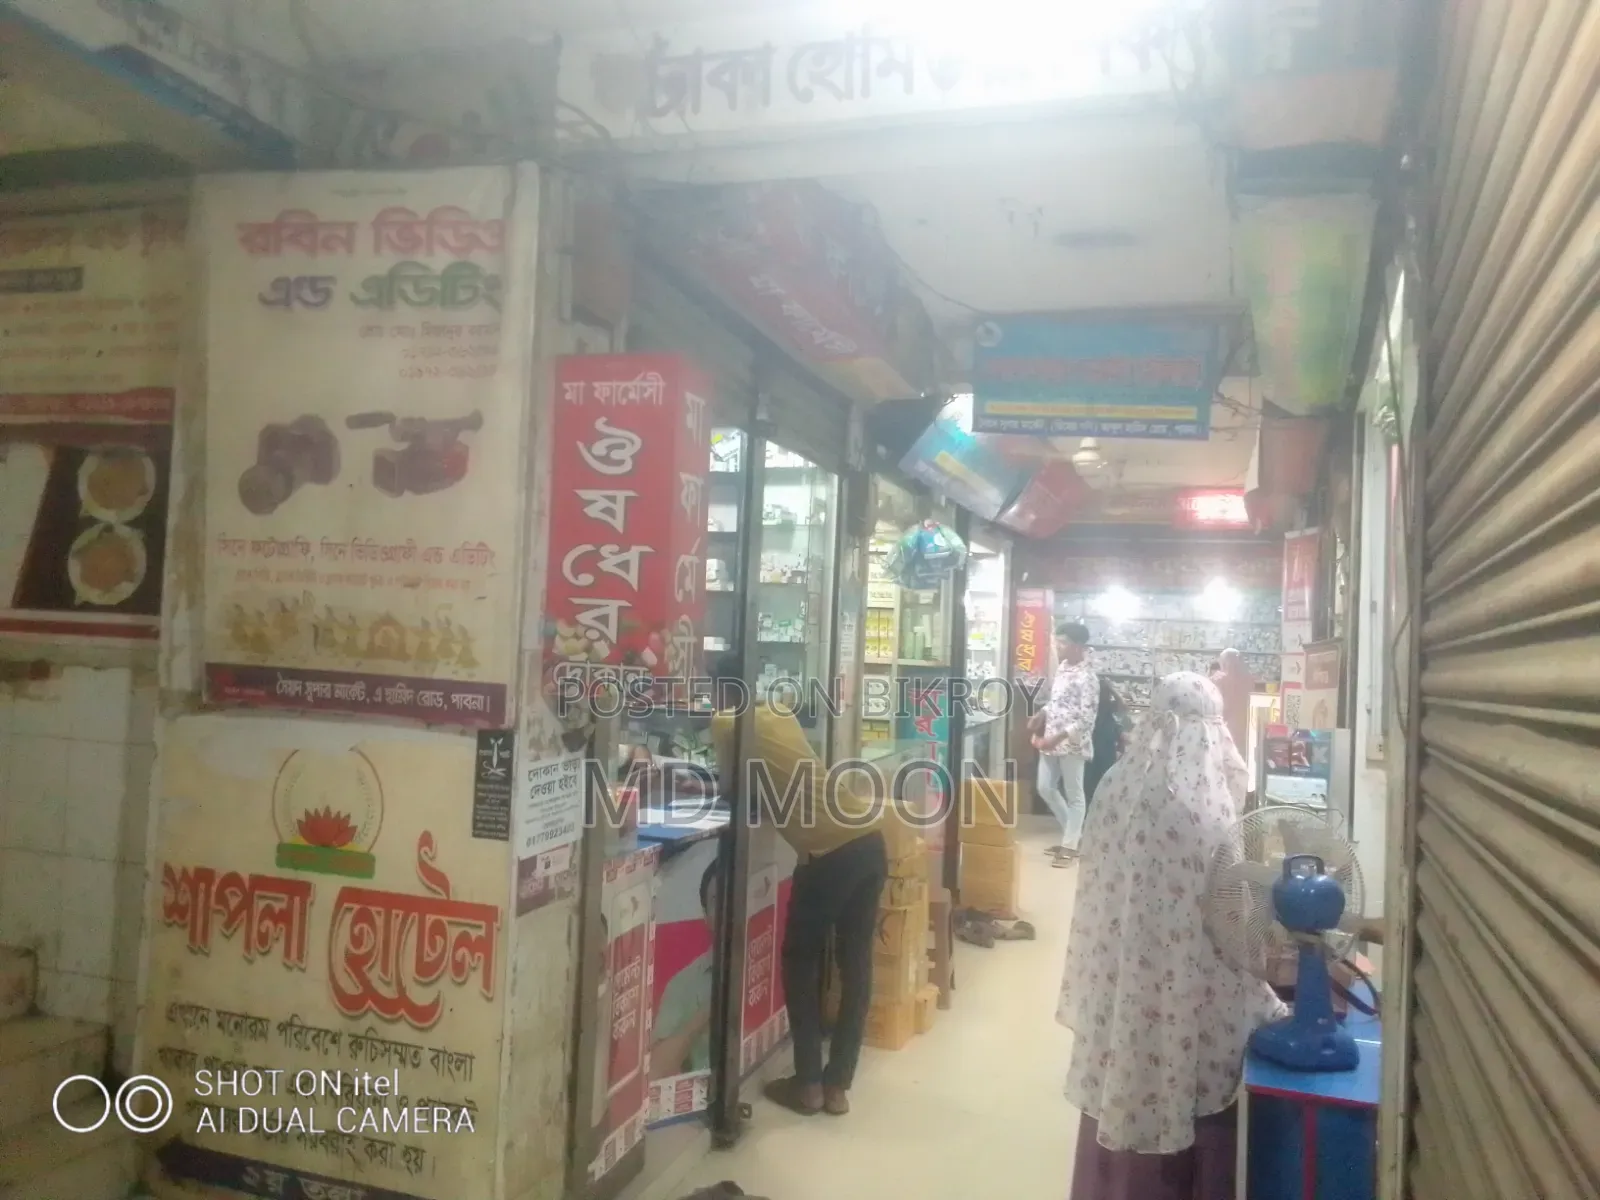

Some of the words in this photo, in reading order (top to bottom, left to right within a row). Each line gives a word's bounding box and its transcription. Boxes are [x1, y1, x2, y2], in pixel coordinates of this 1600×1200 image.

[563, 380, 586, 406] মা
[593, 370, 667, 407] ফার্মেসী
[162, 862, 315, 971] শাপলা
[328, 830, 502, 1028] হোটেল
[215, 1009, 271, 1043] মনোরম
[276, 1013, 343, 1058] পরিবেশে
[428, 1047, 477, 1084] বাংলা
[363, 1135, 397, 1169] করা
